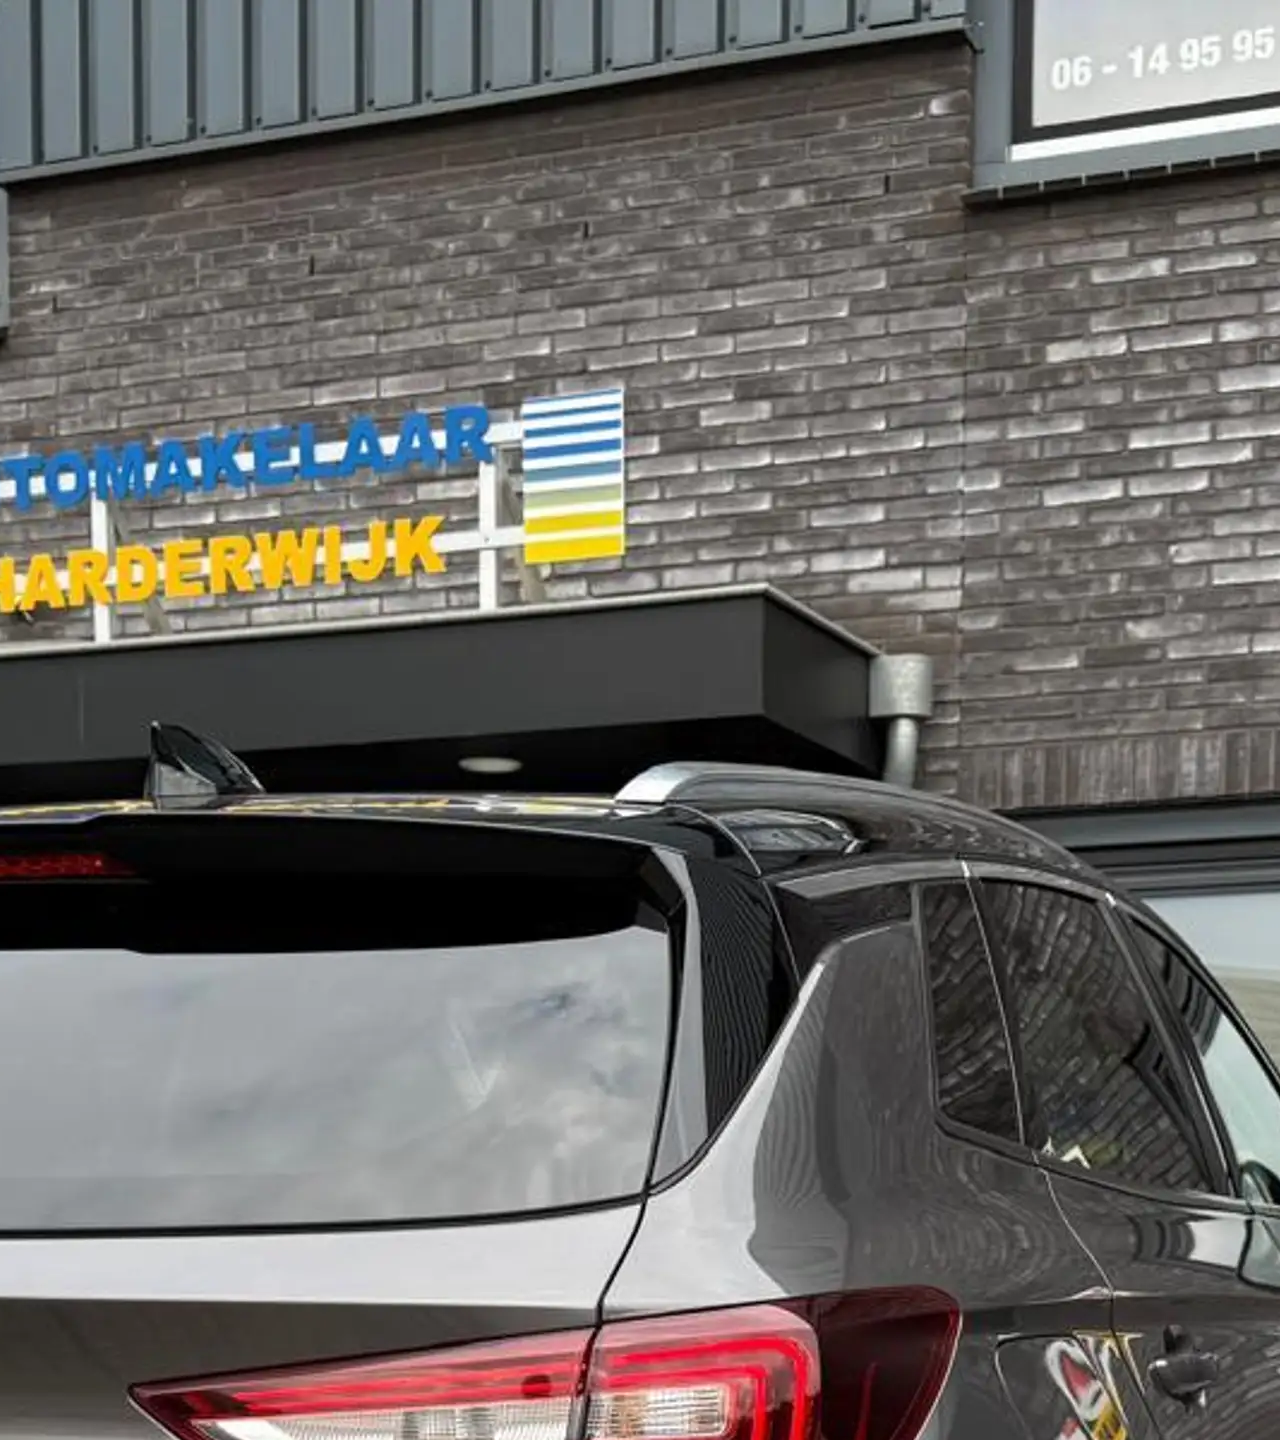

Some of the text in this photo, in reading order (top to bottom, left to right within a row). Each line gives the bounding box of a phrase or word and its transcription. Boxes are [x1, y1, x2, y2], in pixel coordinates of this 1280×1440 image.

[1051, 56, 1092, 90] 06
[1128, 43, 1169, 78] 14
[1179, 35, 1223, 71] 95
[1232, 26, 1275, 61] 95
